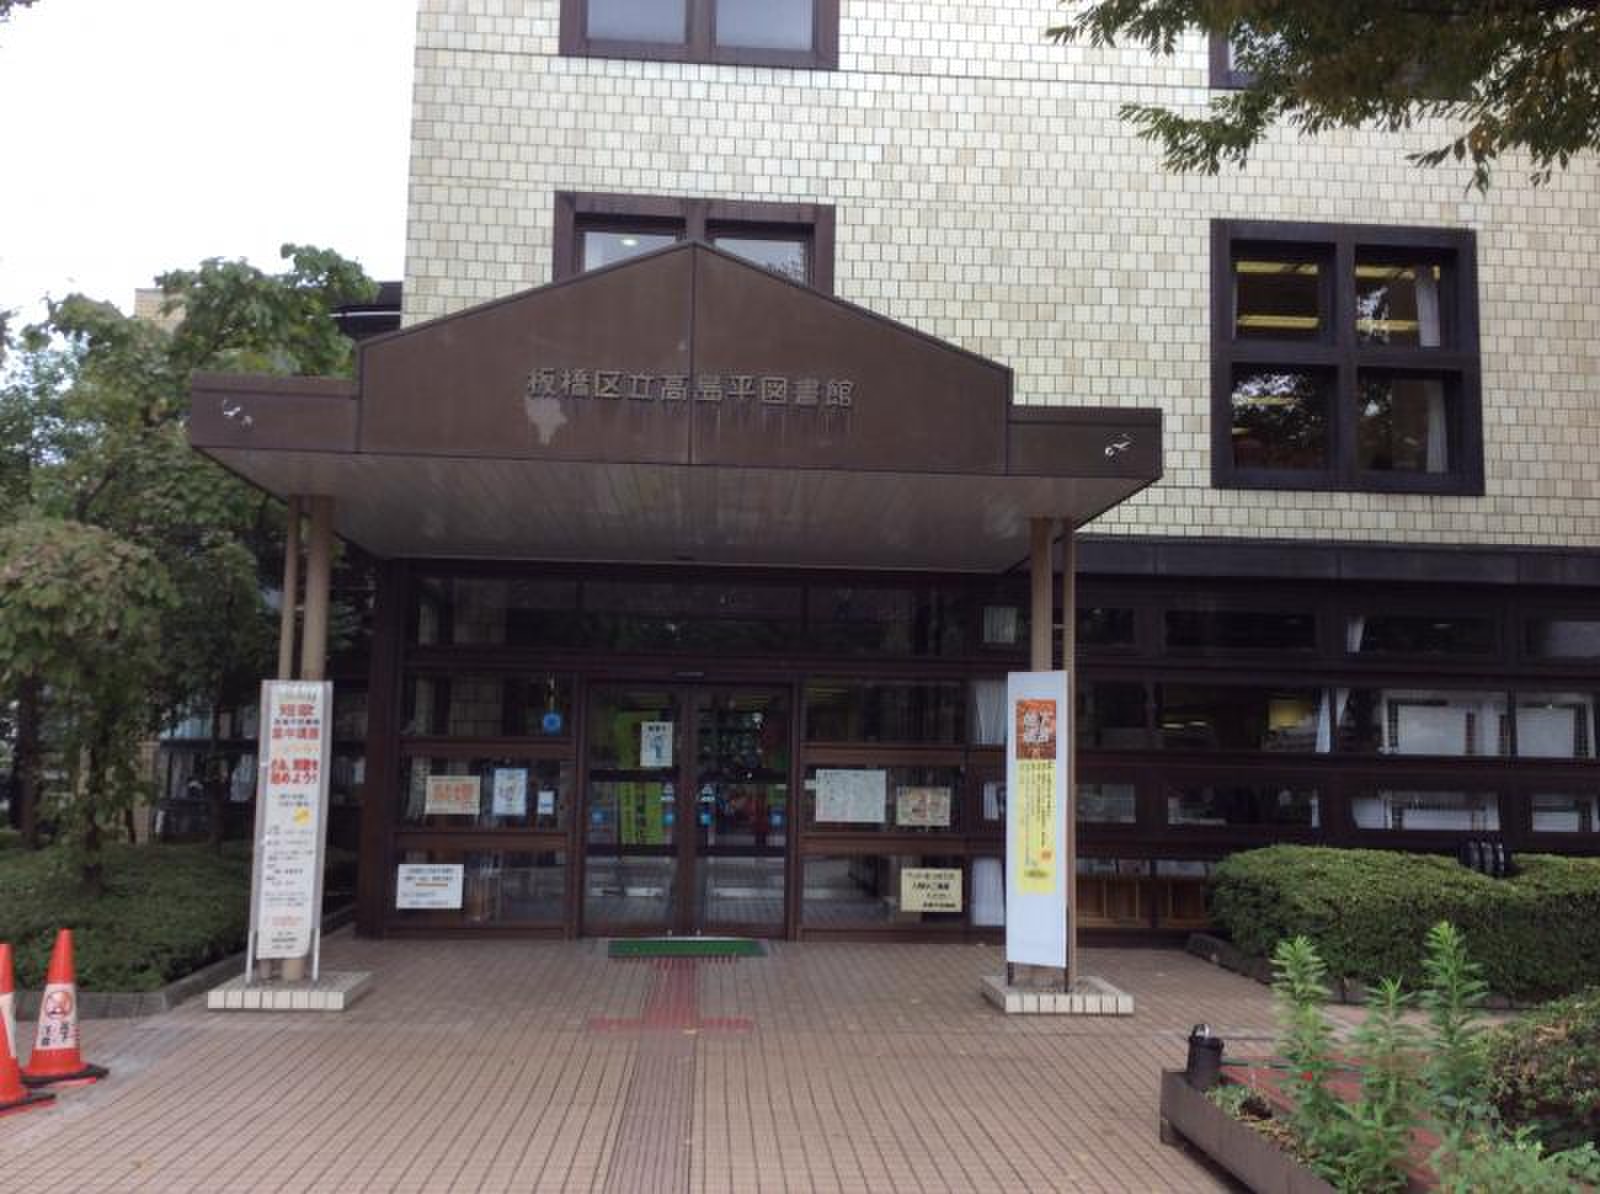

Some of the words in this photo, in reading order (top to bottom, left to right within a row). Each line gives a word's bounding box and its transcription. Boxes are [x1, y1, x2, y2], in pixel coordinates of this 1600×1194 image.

[526, 367, 854, 407] 板橋区立高島平図書館
